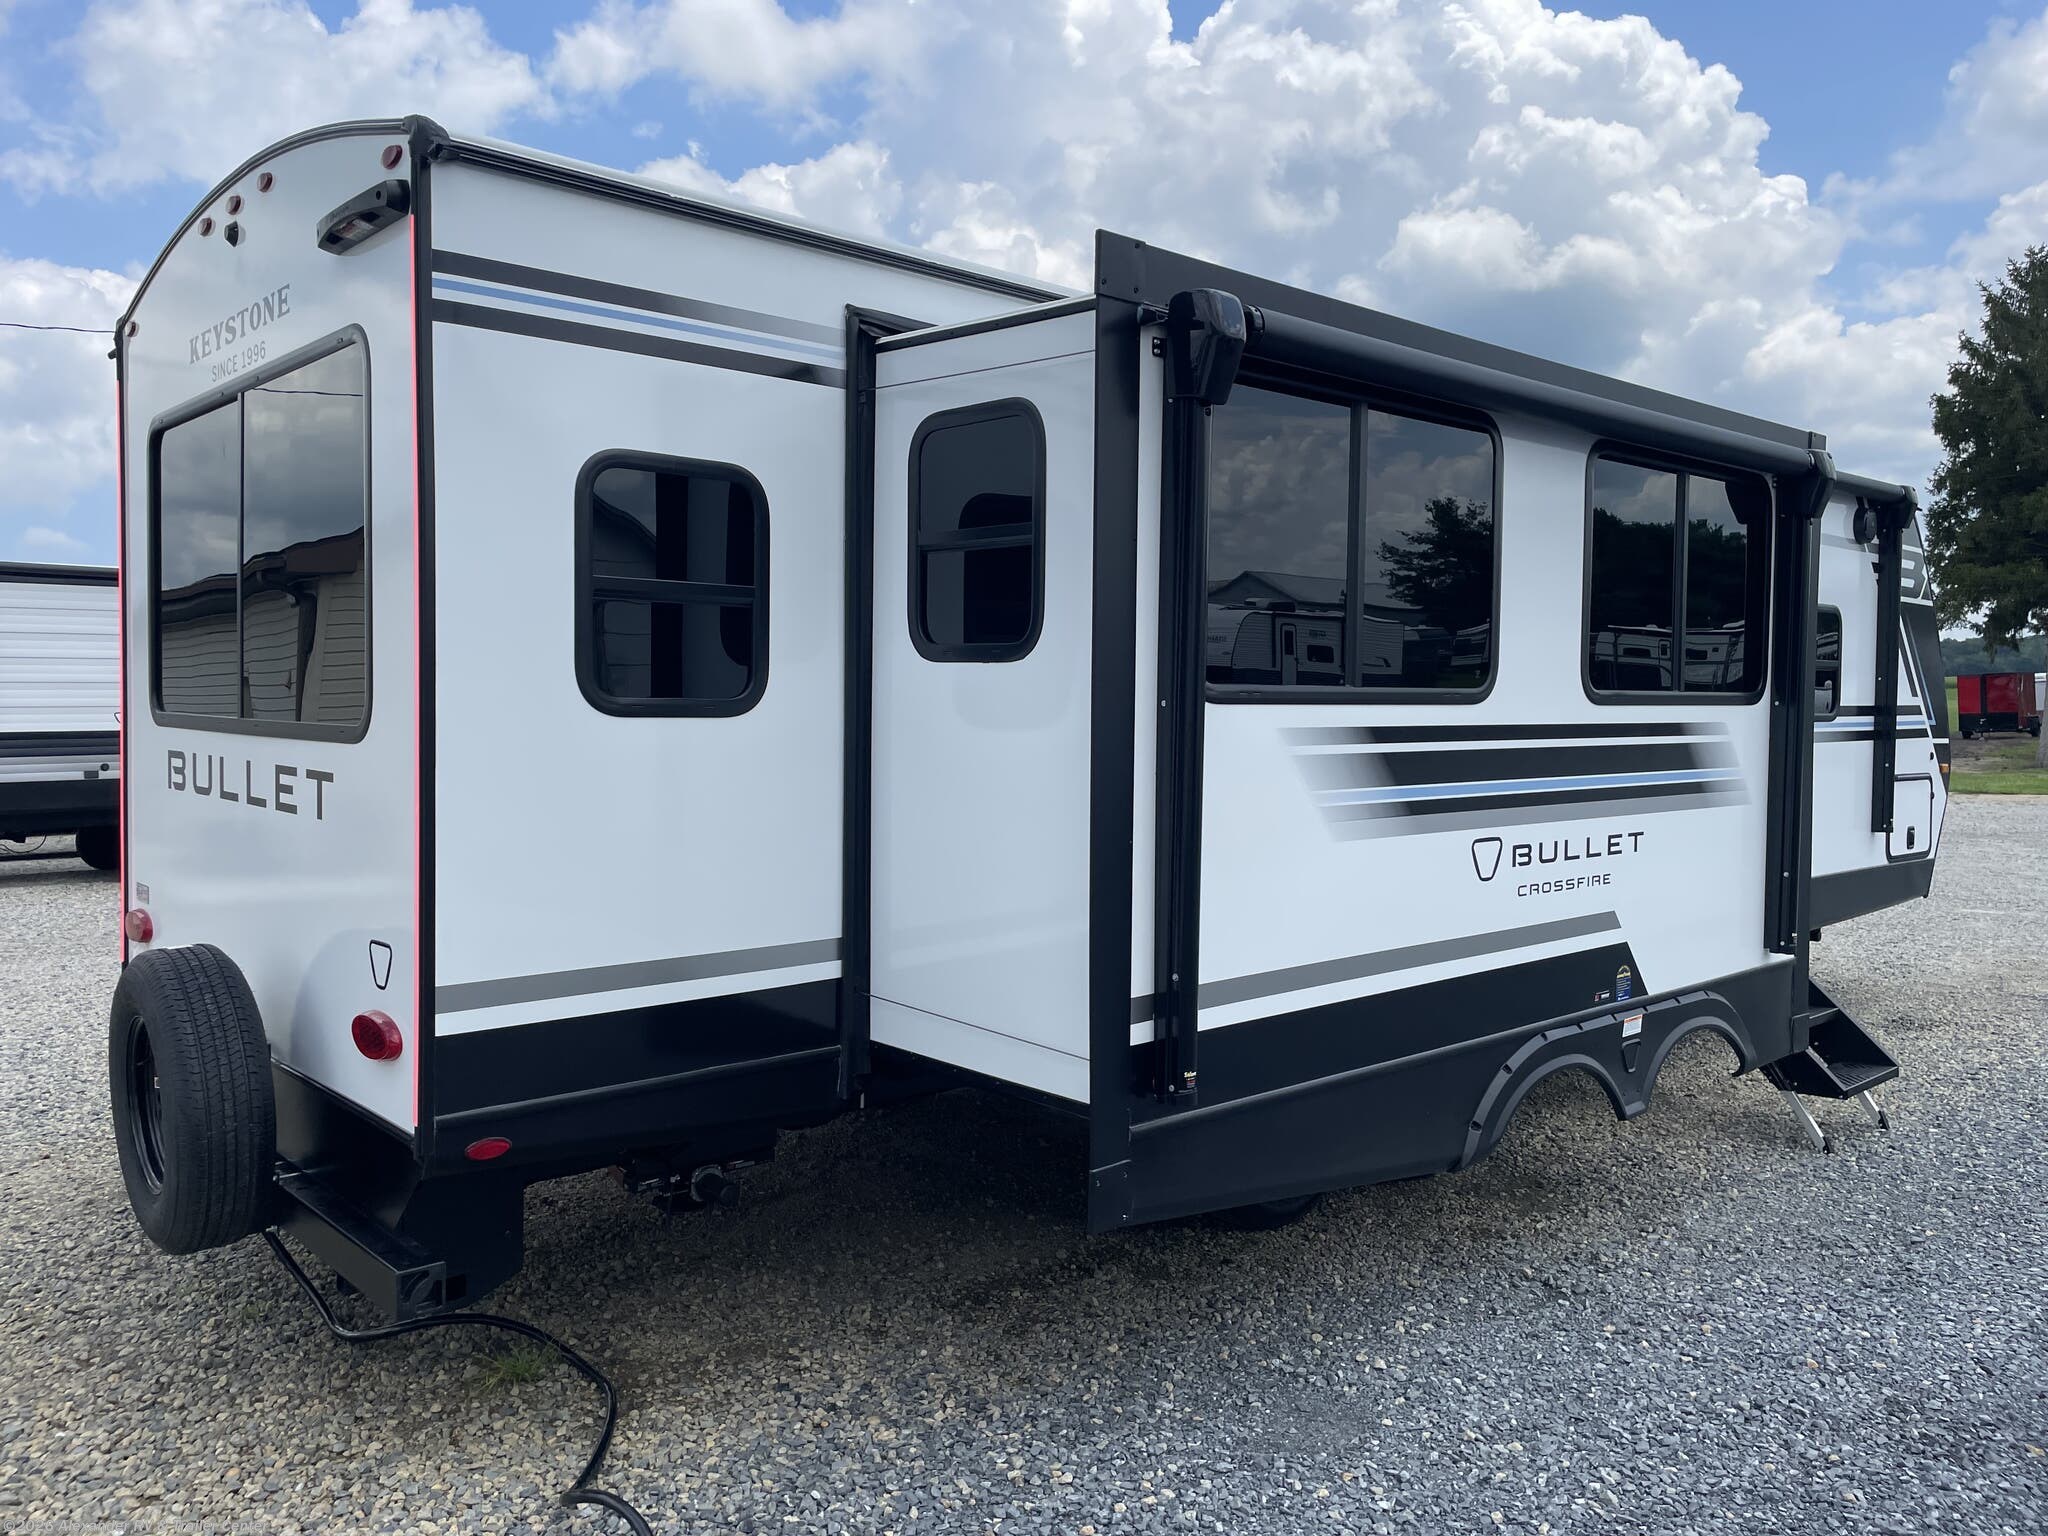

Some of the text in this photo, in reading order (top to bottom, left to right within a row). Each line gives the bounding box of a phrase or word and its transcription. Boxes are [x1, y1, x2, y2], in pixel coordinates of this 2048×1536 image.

[189, 283, 290, 364] KEYSTONE
[211, 340, 266, 382] SINCE 1996
[167, 749, 334, 821] BULLET
[1511, 831, 1645, 868] BULLET
[1517, 873, 1612, 897] CROSSFIRE
